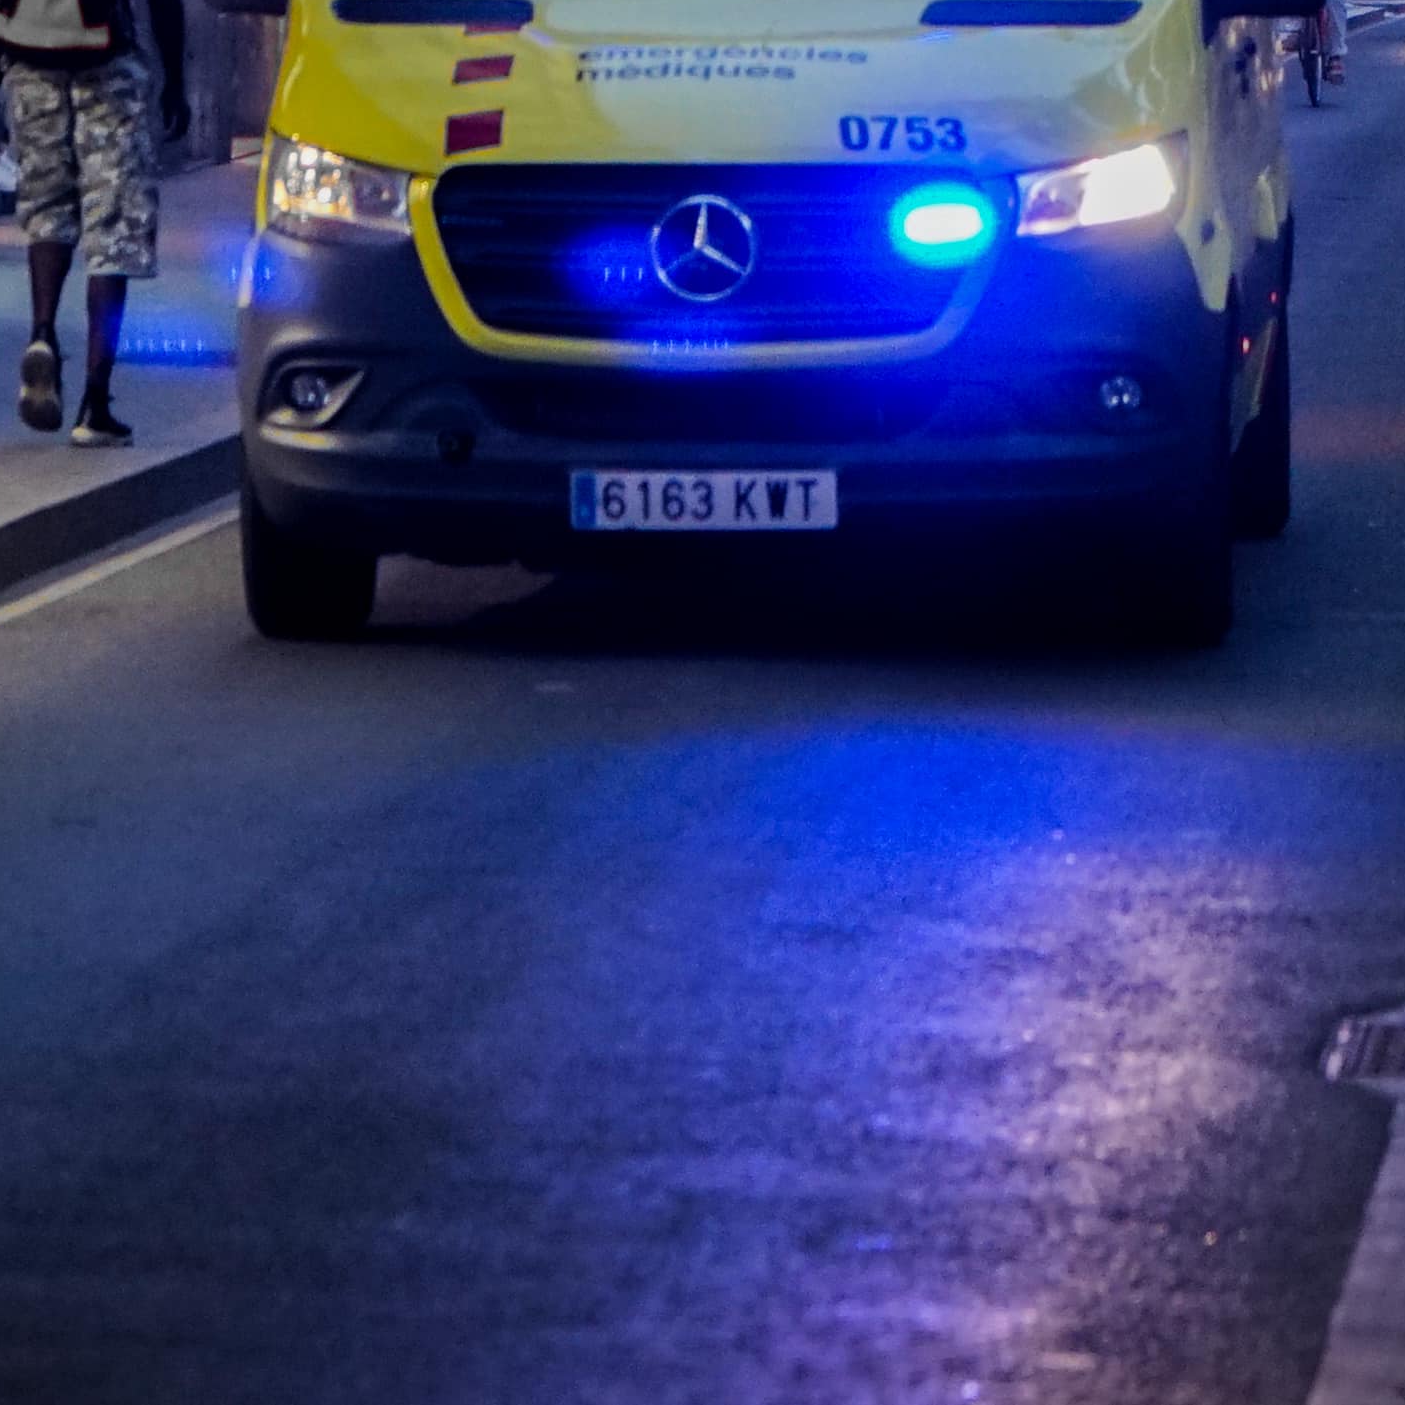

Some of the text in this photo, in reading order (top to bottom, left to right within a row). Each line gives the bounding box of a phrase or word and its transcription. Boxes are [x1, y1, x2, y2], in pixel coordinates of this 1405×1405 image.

[839, 114, 968, 152] 0753
[602, 477, 818, 522] 6163 KWT
